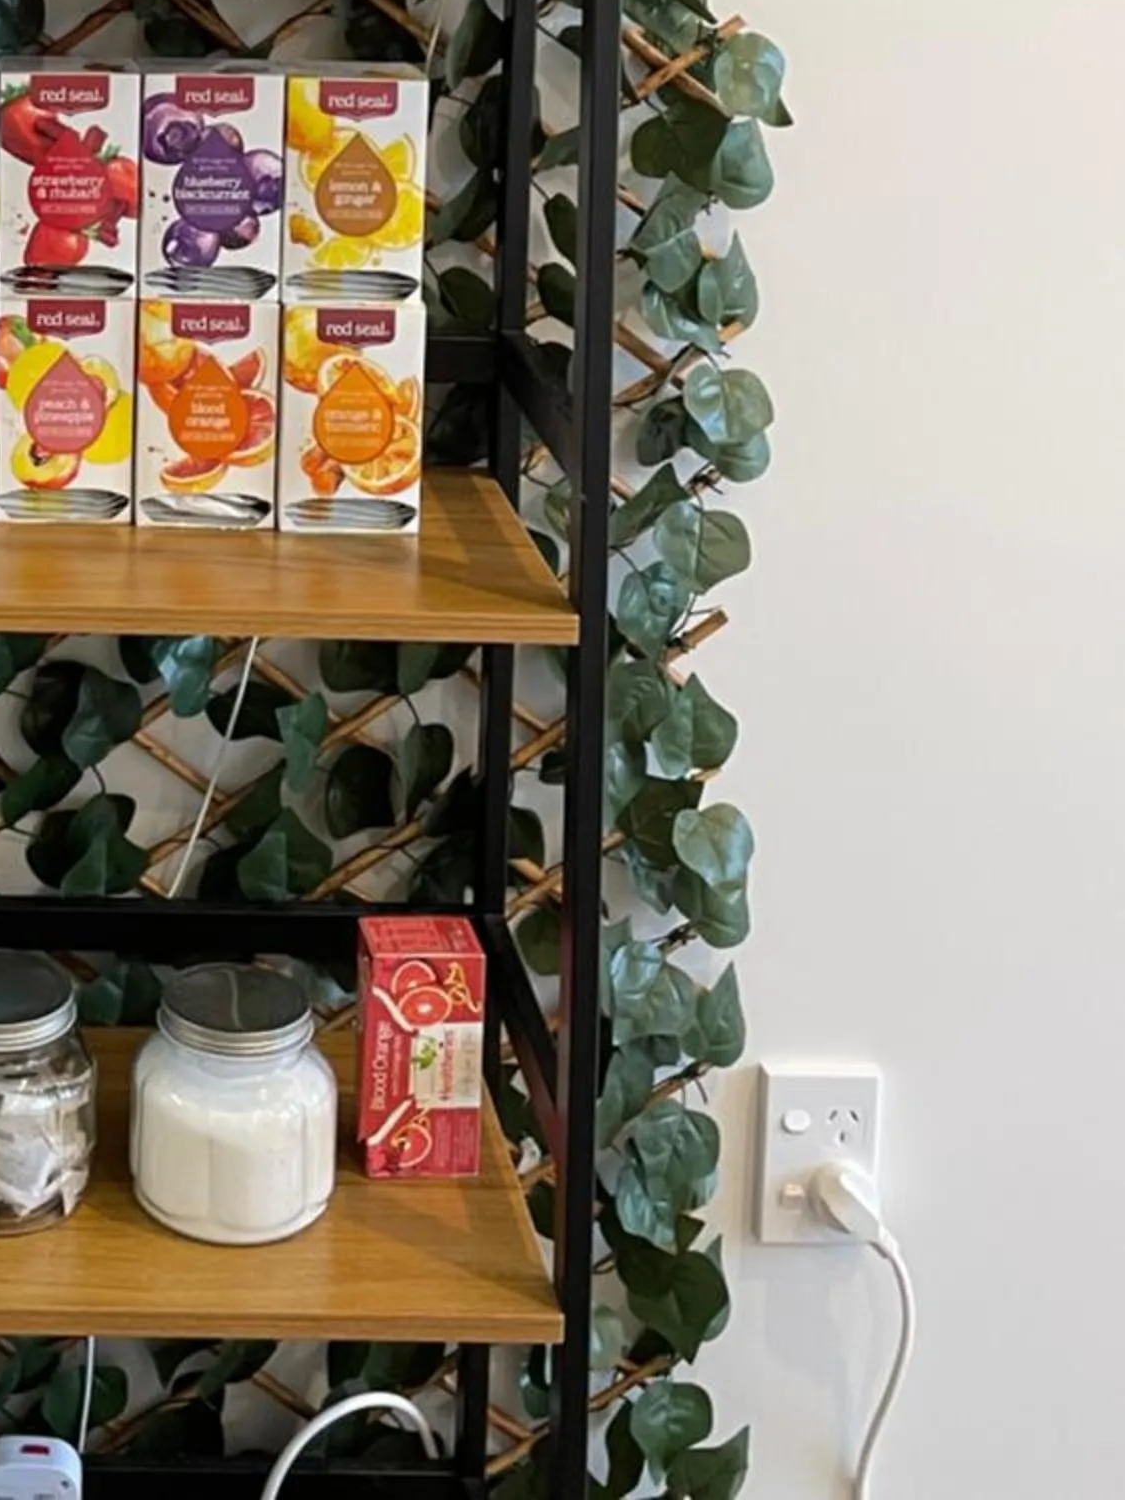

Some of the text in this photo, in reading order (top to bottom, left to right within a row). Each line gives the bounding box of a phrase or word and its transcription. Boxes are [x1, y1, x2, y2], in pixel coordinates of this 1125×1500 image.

[40, 87, 67, 102] red
[185, 88, 211, 104] red
[328, 93, 355, 109] red
[32, 174, 105, 190] strawberry
[183, 175, 243, 191] blueberry
[37, 311, 63, 327] red
[181, 316, 207, 332] red
[326, 321, 353, 336] red
